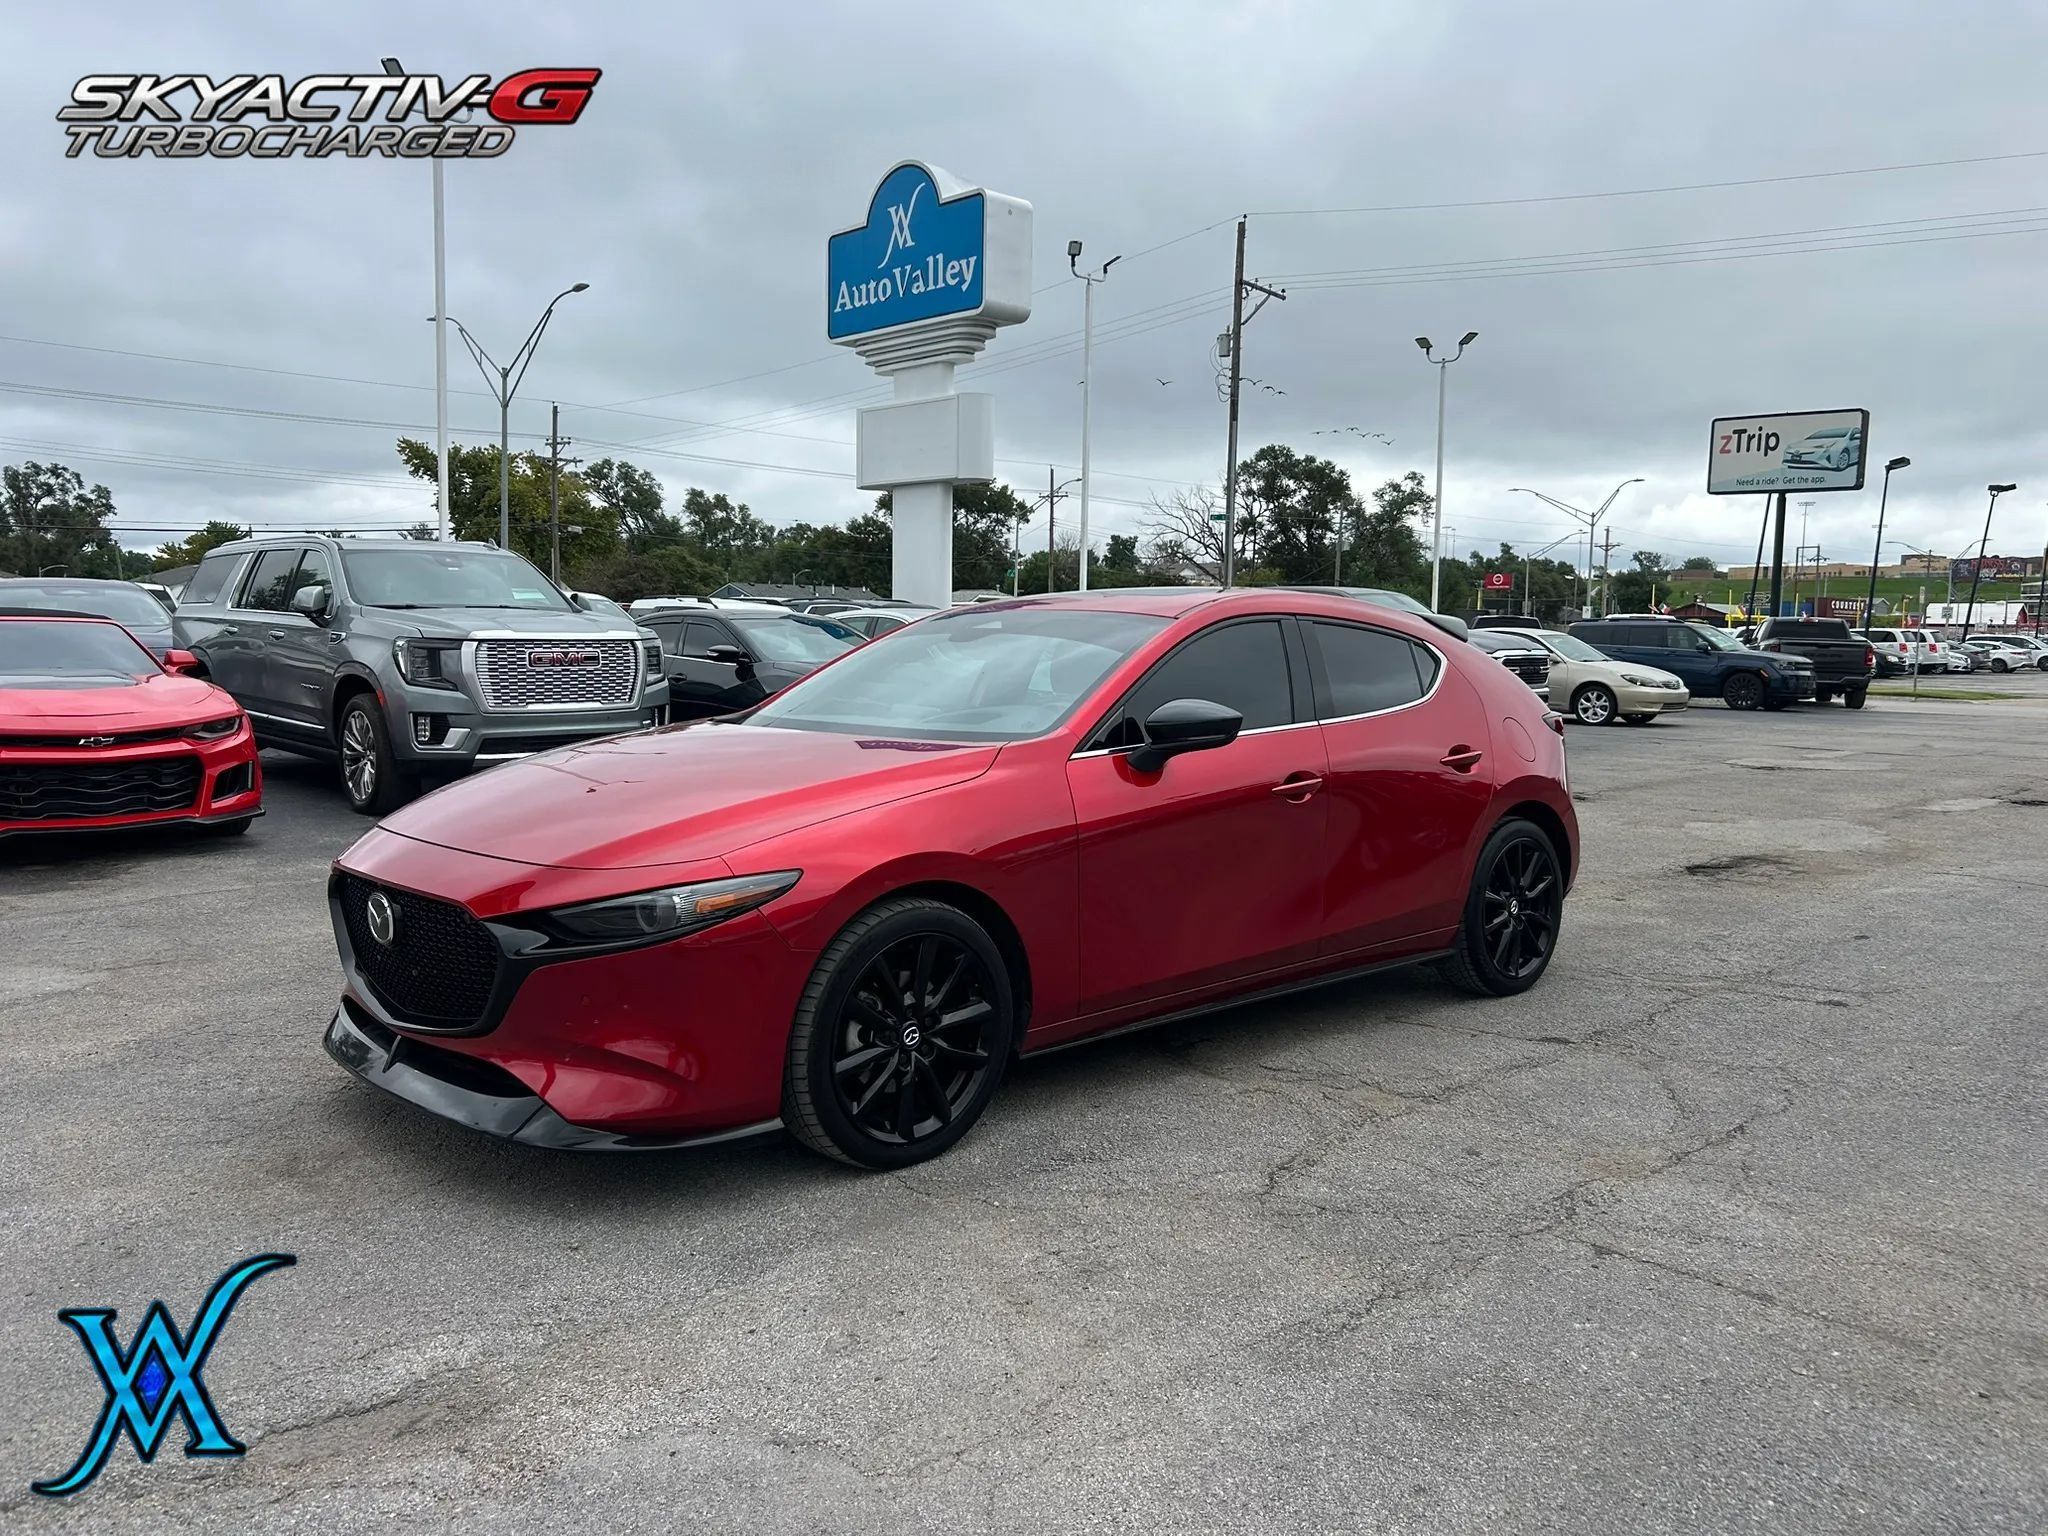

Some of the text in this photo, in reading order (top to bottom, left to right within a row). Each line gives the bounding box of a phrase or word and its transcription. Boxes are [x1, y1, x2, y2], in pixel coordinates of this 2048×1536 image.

[1719, 426, 1780, 457] zTrip
[1736, 477, 1754, 486] Need
[1761, 476, 1779, 485] ride?
[1782, 476, 1796, 484] Get
[1797, 475, 1809, 484] the
[530, 651, 599, 667] GMC
